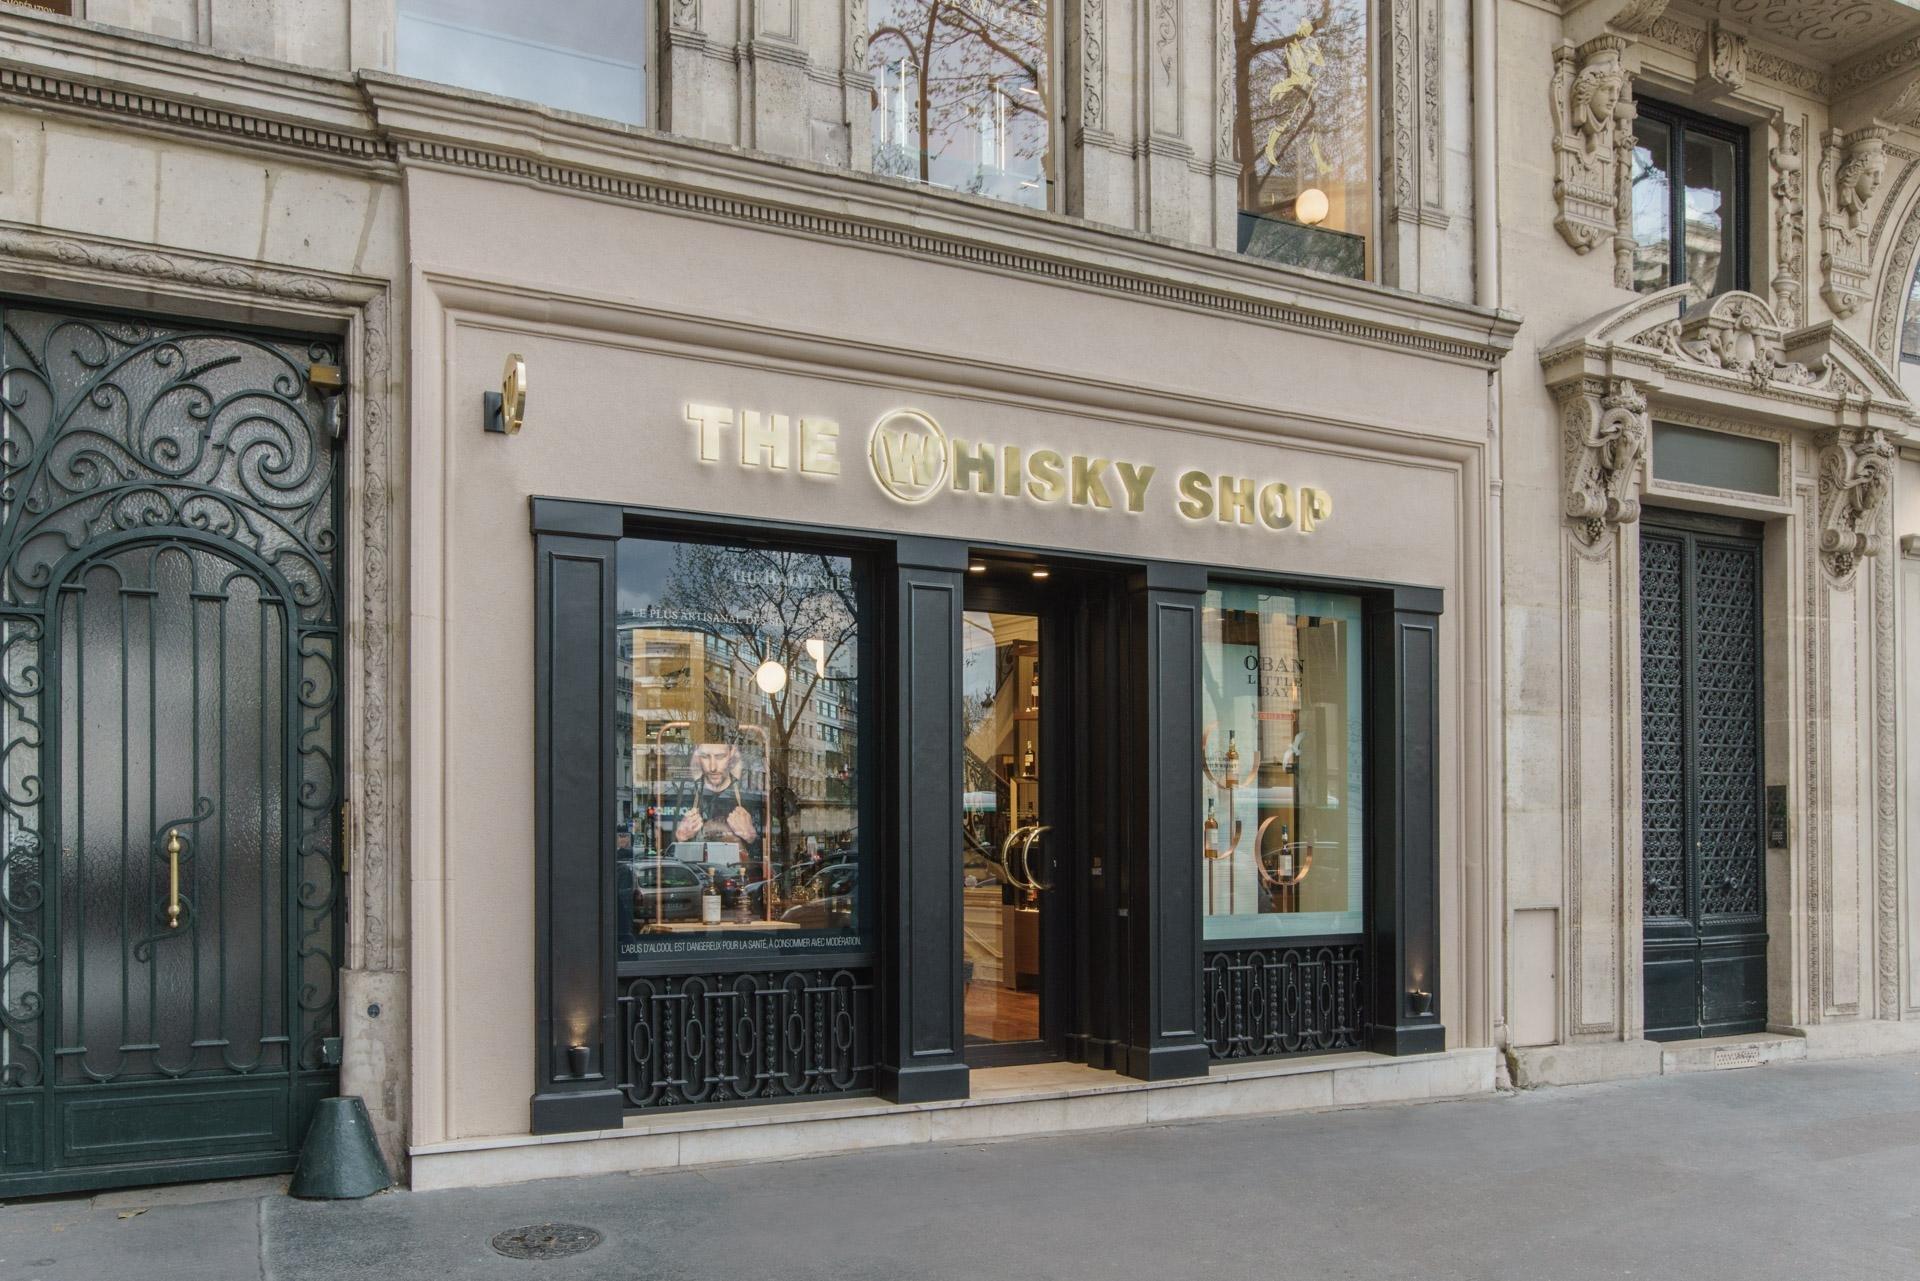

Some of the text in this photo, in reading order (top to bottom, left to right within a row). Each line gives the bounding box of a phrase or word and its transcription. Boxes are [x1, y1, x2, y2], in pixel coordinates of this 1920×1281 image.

[685, 402, 1333, 534] THE WHISKY SHOP
[764, 568, 845, 592] BLVENIE
[632, 607, 648, 618] LE
[649, 608, 678, 620] PLUS
[681, 612, 742, 624] ARTISANAL
[1244, 655, 1304, 674] OBAN
[1247, 674, 1303, 688] LTTLE
[1262, 687, 1289, 698] BAY
[621, 943, 643, 954] L'ABUS
[643, 942, 674, 953] D'ALCOOL
[674, 942, 686, 952] EST
[686, 941, 722, 951] DANGEREUX
[722, 940, 739, 950] POUR
[739, 939, 747, 950] LA
[768, 937, 774, 948] À
[774, 938, 811, 948] CONSOMMER
[811, 937, 825, 947] AVEC
